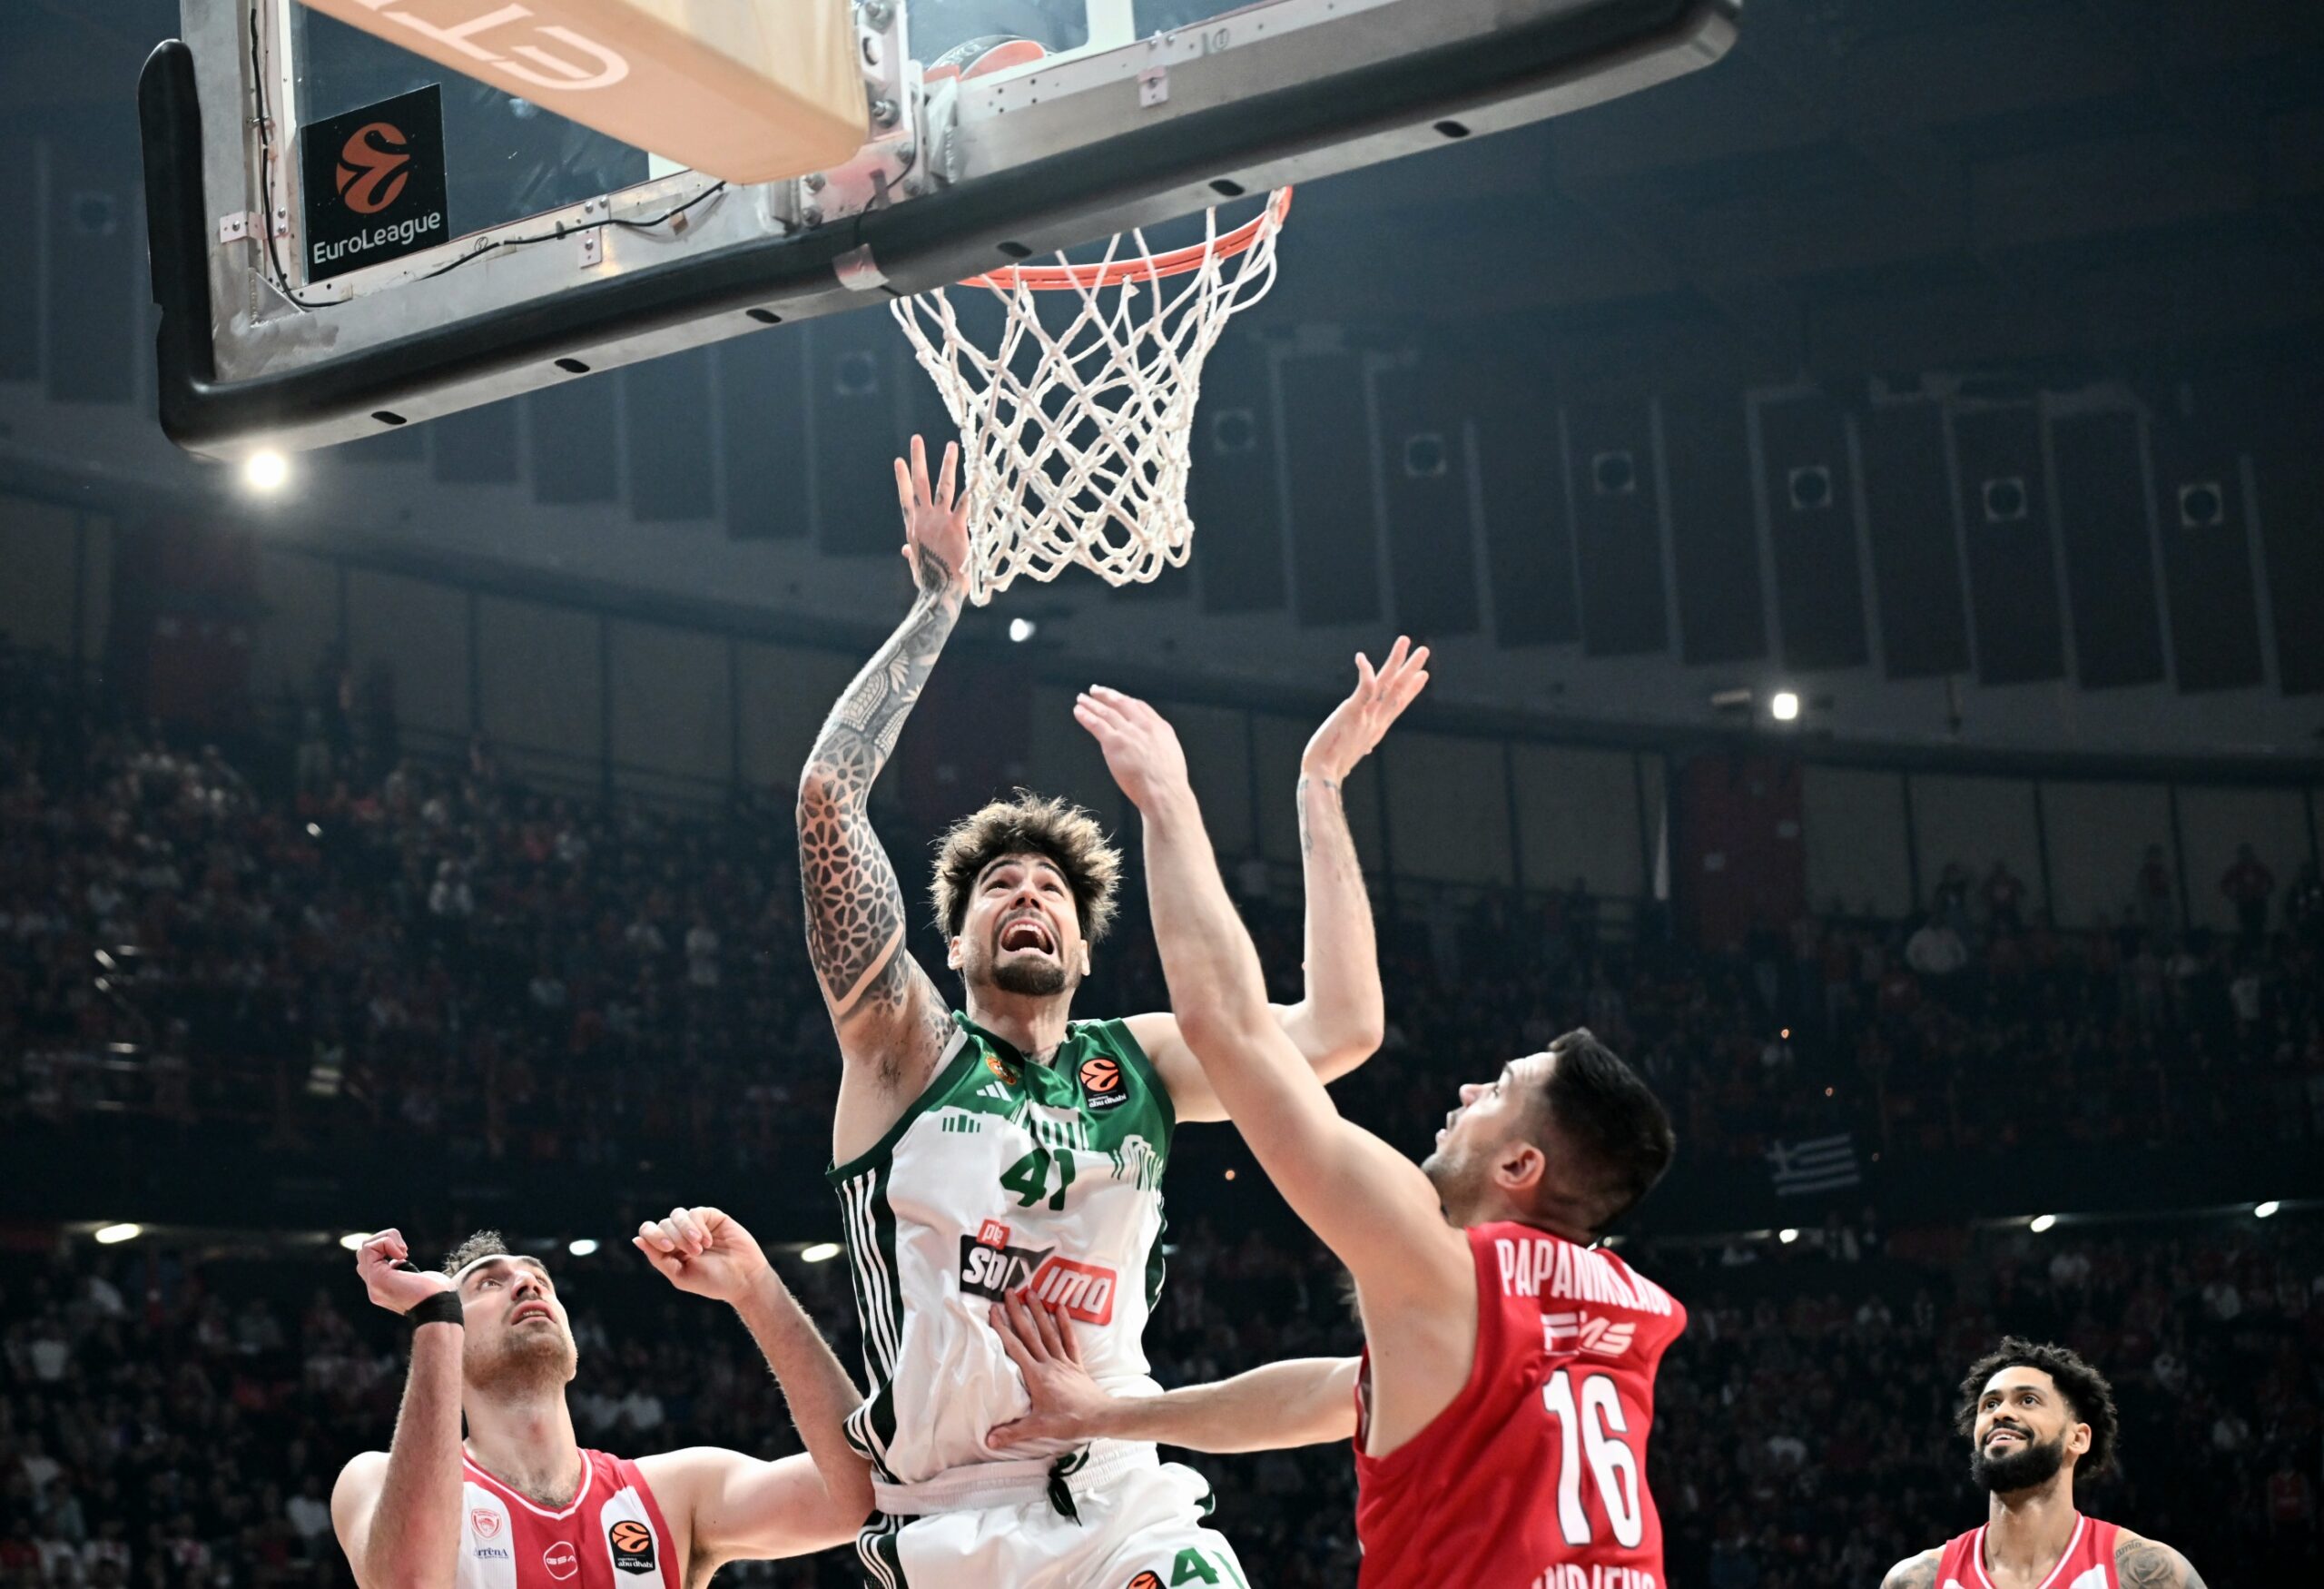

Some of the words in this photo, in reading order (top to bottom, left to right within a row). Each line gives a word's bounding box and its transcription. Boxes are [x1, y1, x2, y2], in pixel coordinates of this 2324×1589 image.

[354, 0, 630, 91] ET
[313, 212, 441, 264] EuroLeague
[1000, 1147, 1076, 1210] 41
[1542, 1369, 1643, 1549] 16
